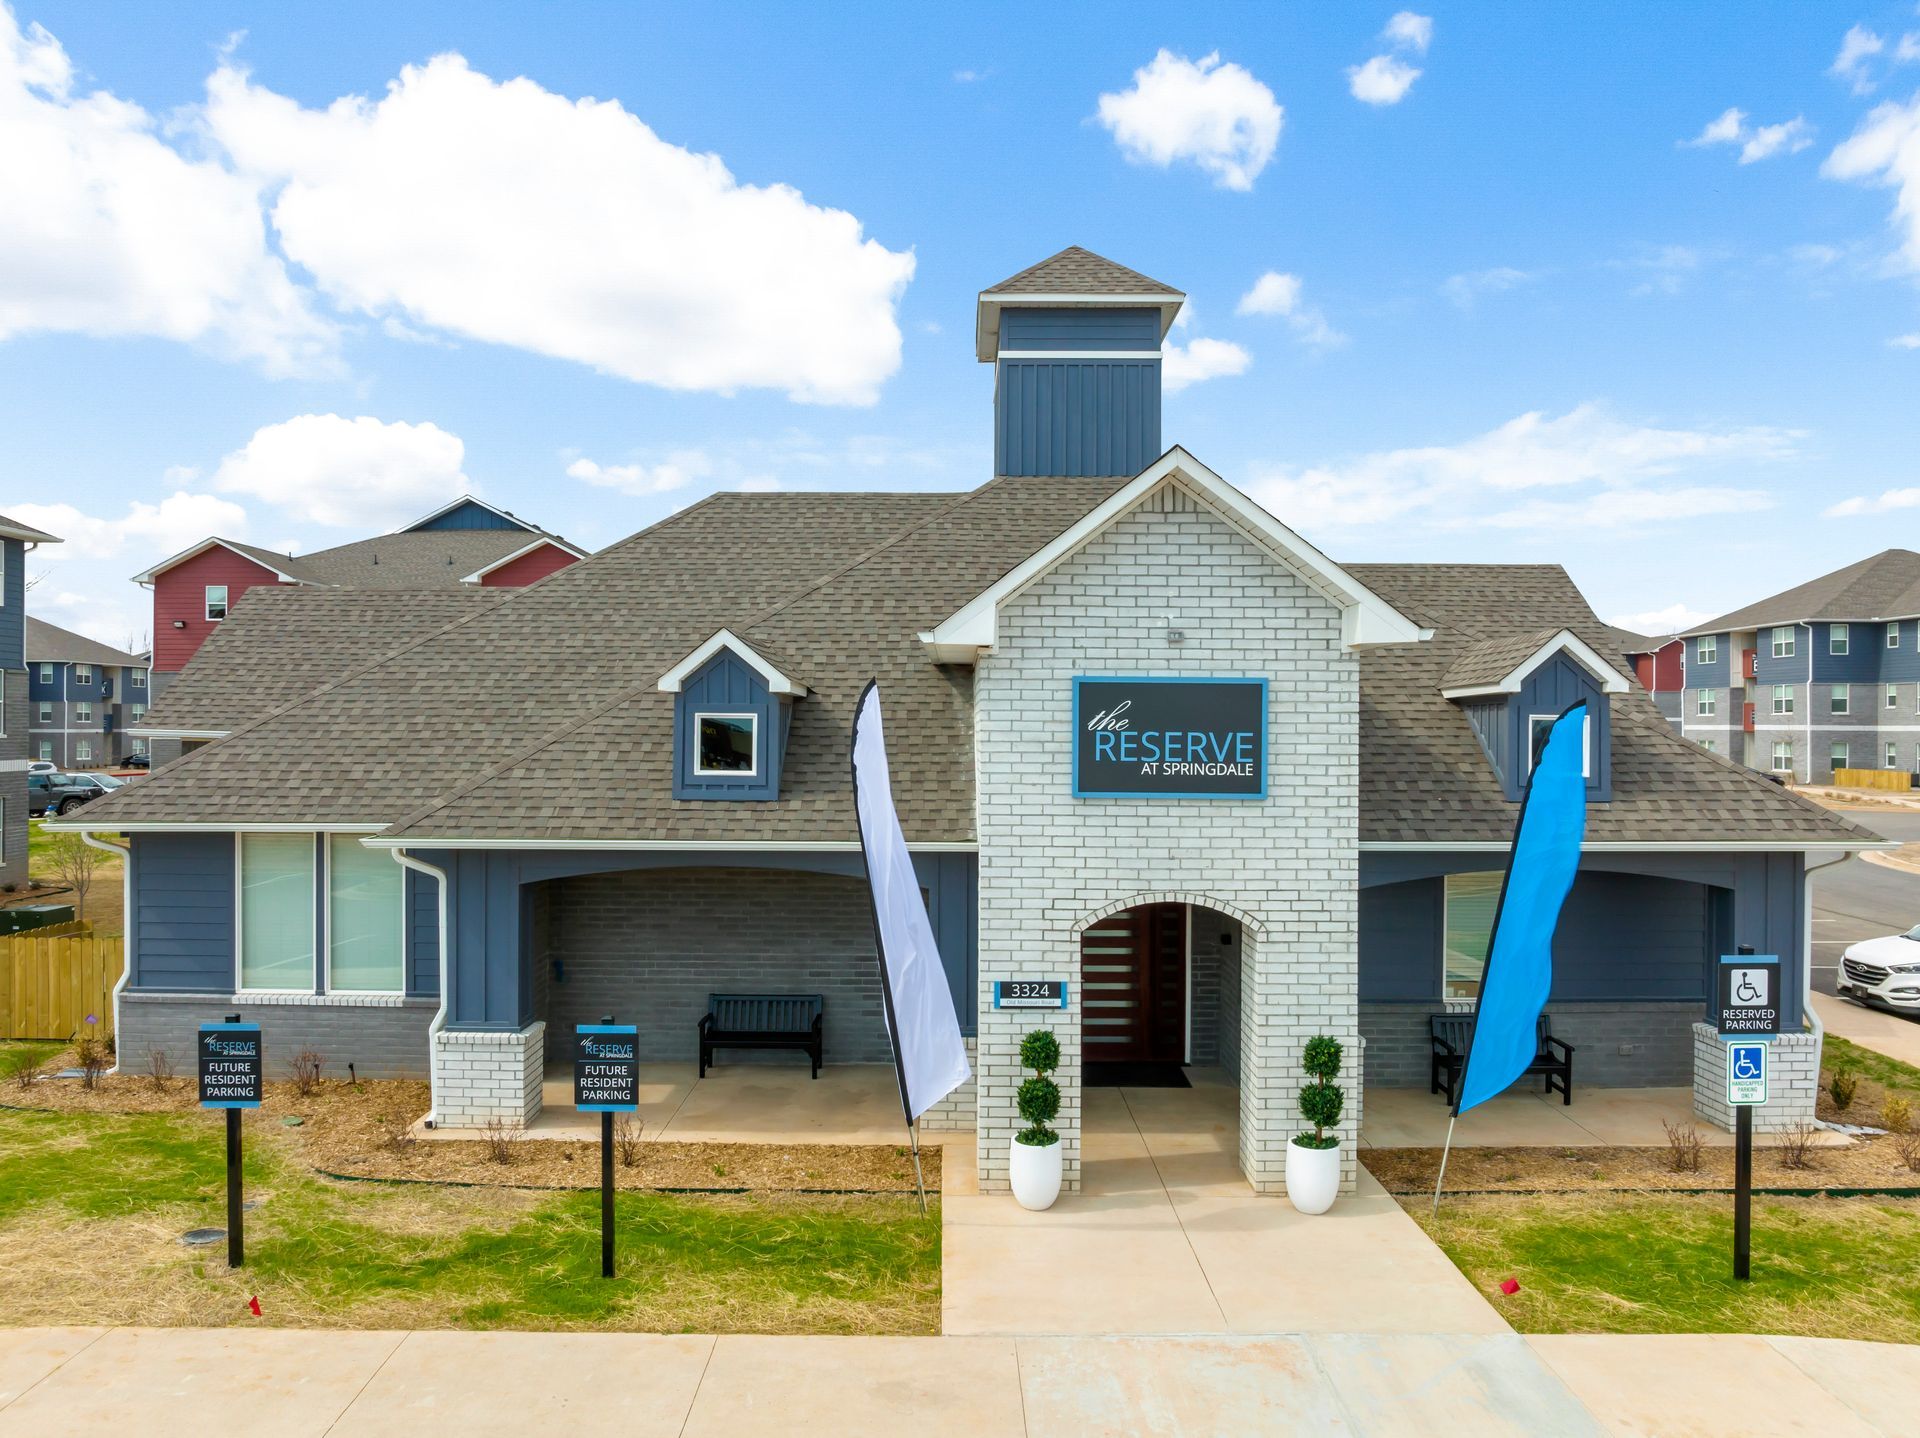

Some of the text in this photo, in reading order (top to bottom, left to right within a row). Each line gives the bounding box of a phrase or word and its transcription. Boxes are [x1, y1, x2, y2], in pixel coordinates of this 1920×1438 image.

[1087, 700, 1132, 731] the
[1095, 731, 1254, 763] RESERVE
[1141, 763, 1254, 776] AT SPRINGDALE
[1011, 984, 1050, 997] 3324
[1722, 1009, 1775, 1019] RESERVED
[1725, 1020, 1772, 1030] PARKING
[209, 1041, 256, 1051] RESERVE
[585, 1044, 633, 1054] RESERVE
[209, 1063, 251, 1072] FUTURE
[585, 1065, 628, 1075] FUTURE
[204, 1075, 256, 1084] RESIDENT
[580, 1077, 633, 1087] RESIDENT
[207, 1087, 254, 1096] PARKING
[582, 1090, 631, 1100] PARKING
